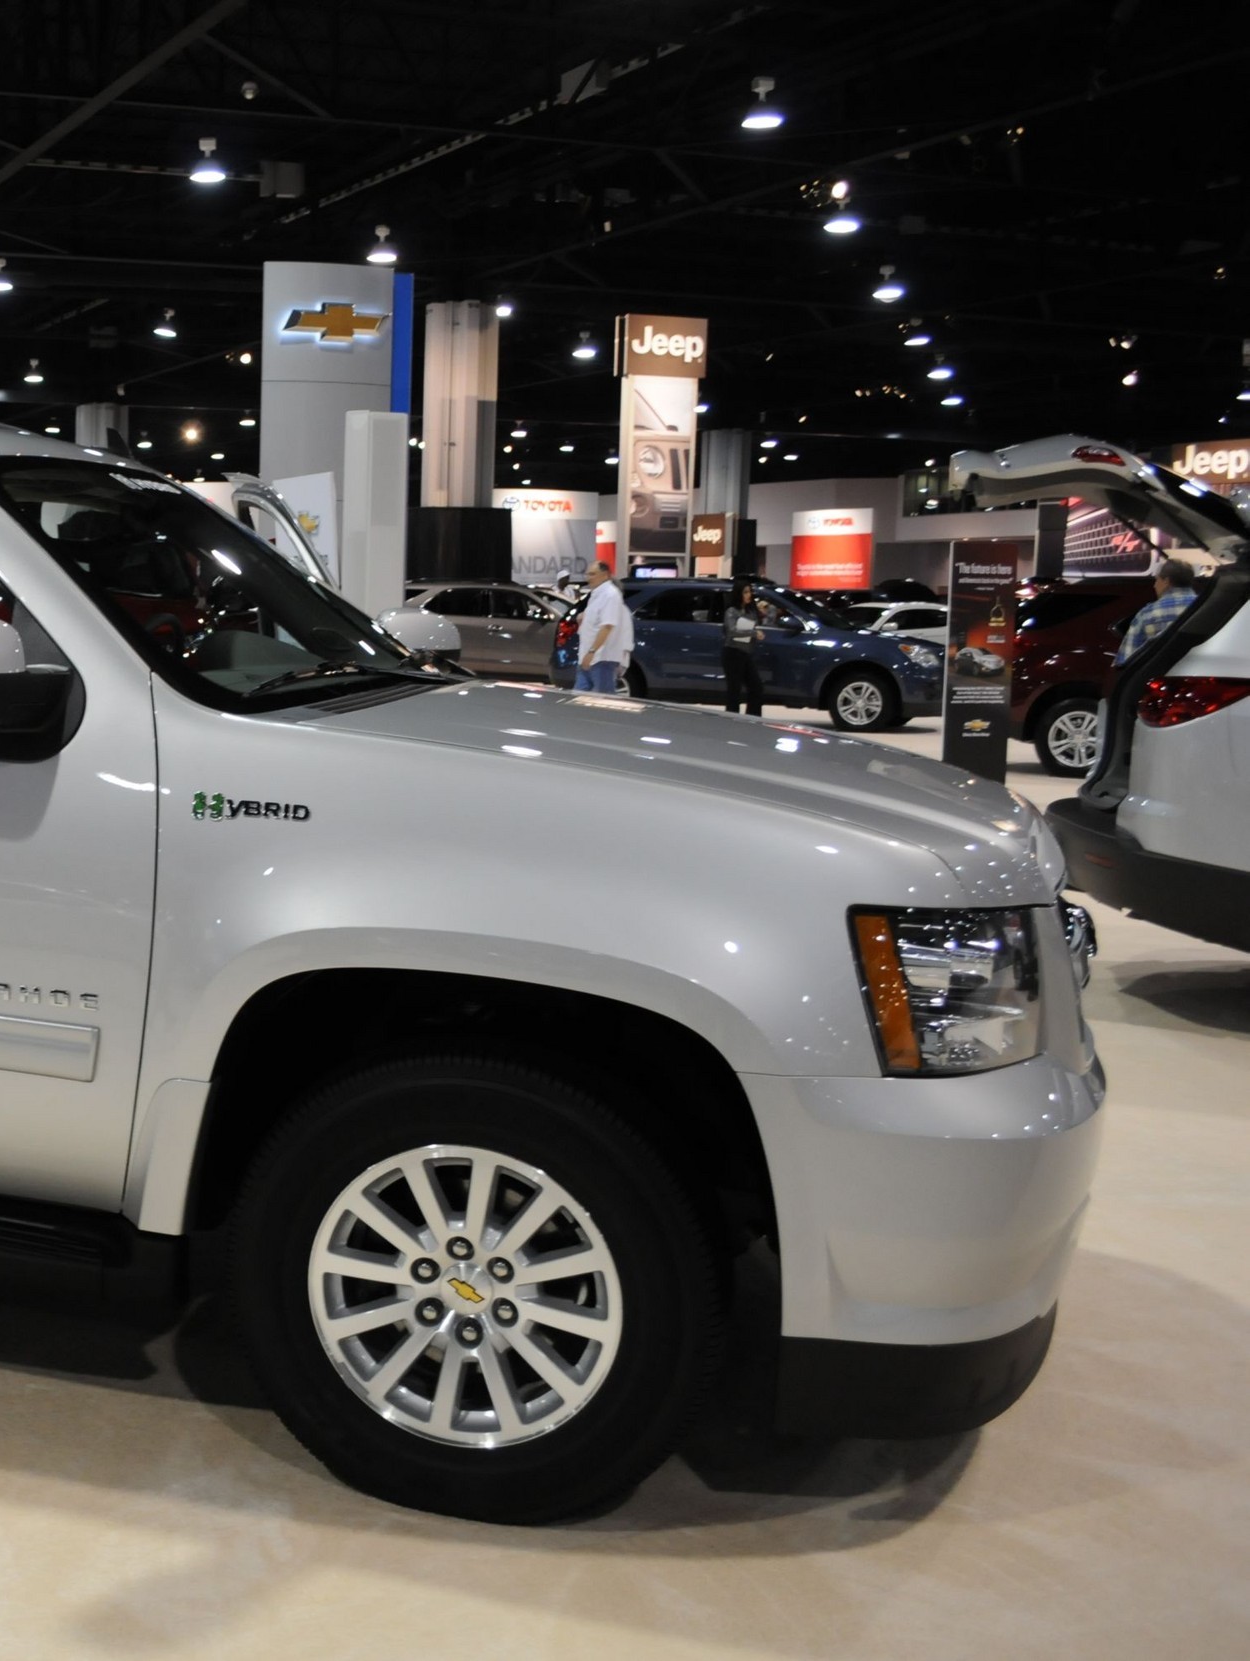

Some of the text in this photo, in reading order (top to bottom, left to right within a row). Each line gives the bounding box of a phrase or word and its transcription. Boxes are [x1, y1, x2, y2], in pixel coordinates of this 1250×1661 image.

[631, 325, 704, 363] Jeep
[1173, 444, 1248, 479] Jeep
[524, 500, 573, 512] TOYOTA
[693, 525, 722, 544] Jeep
